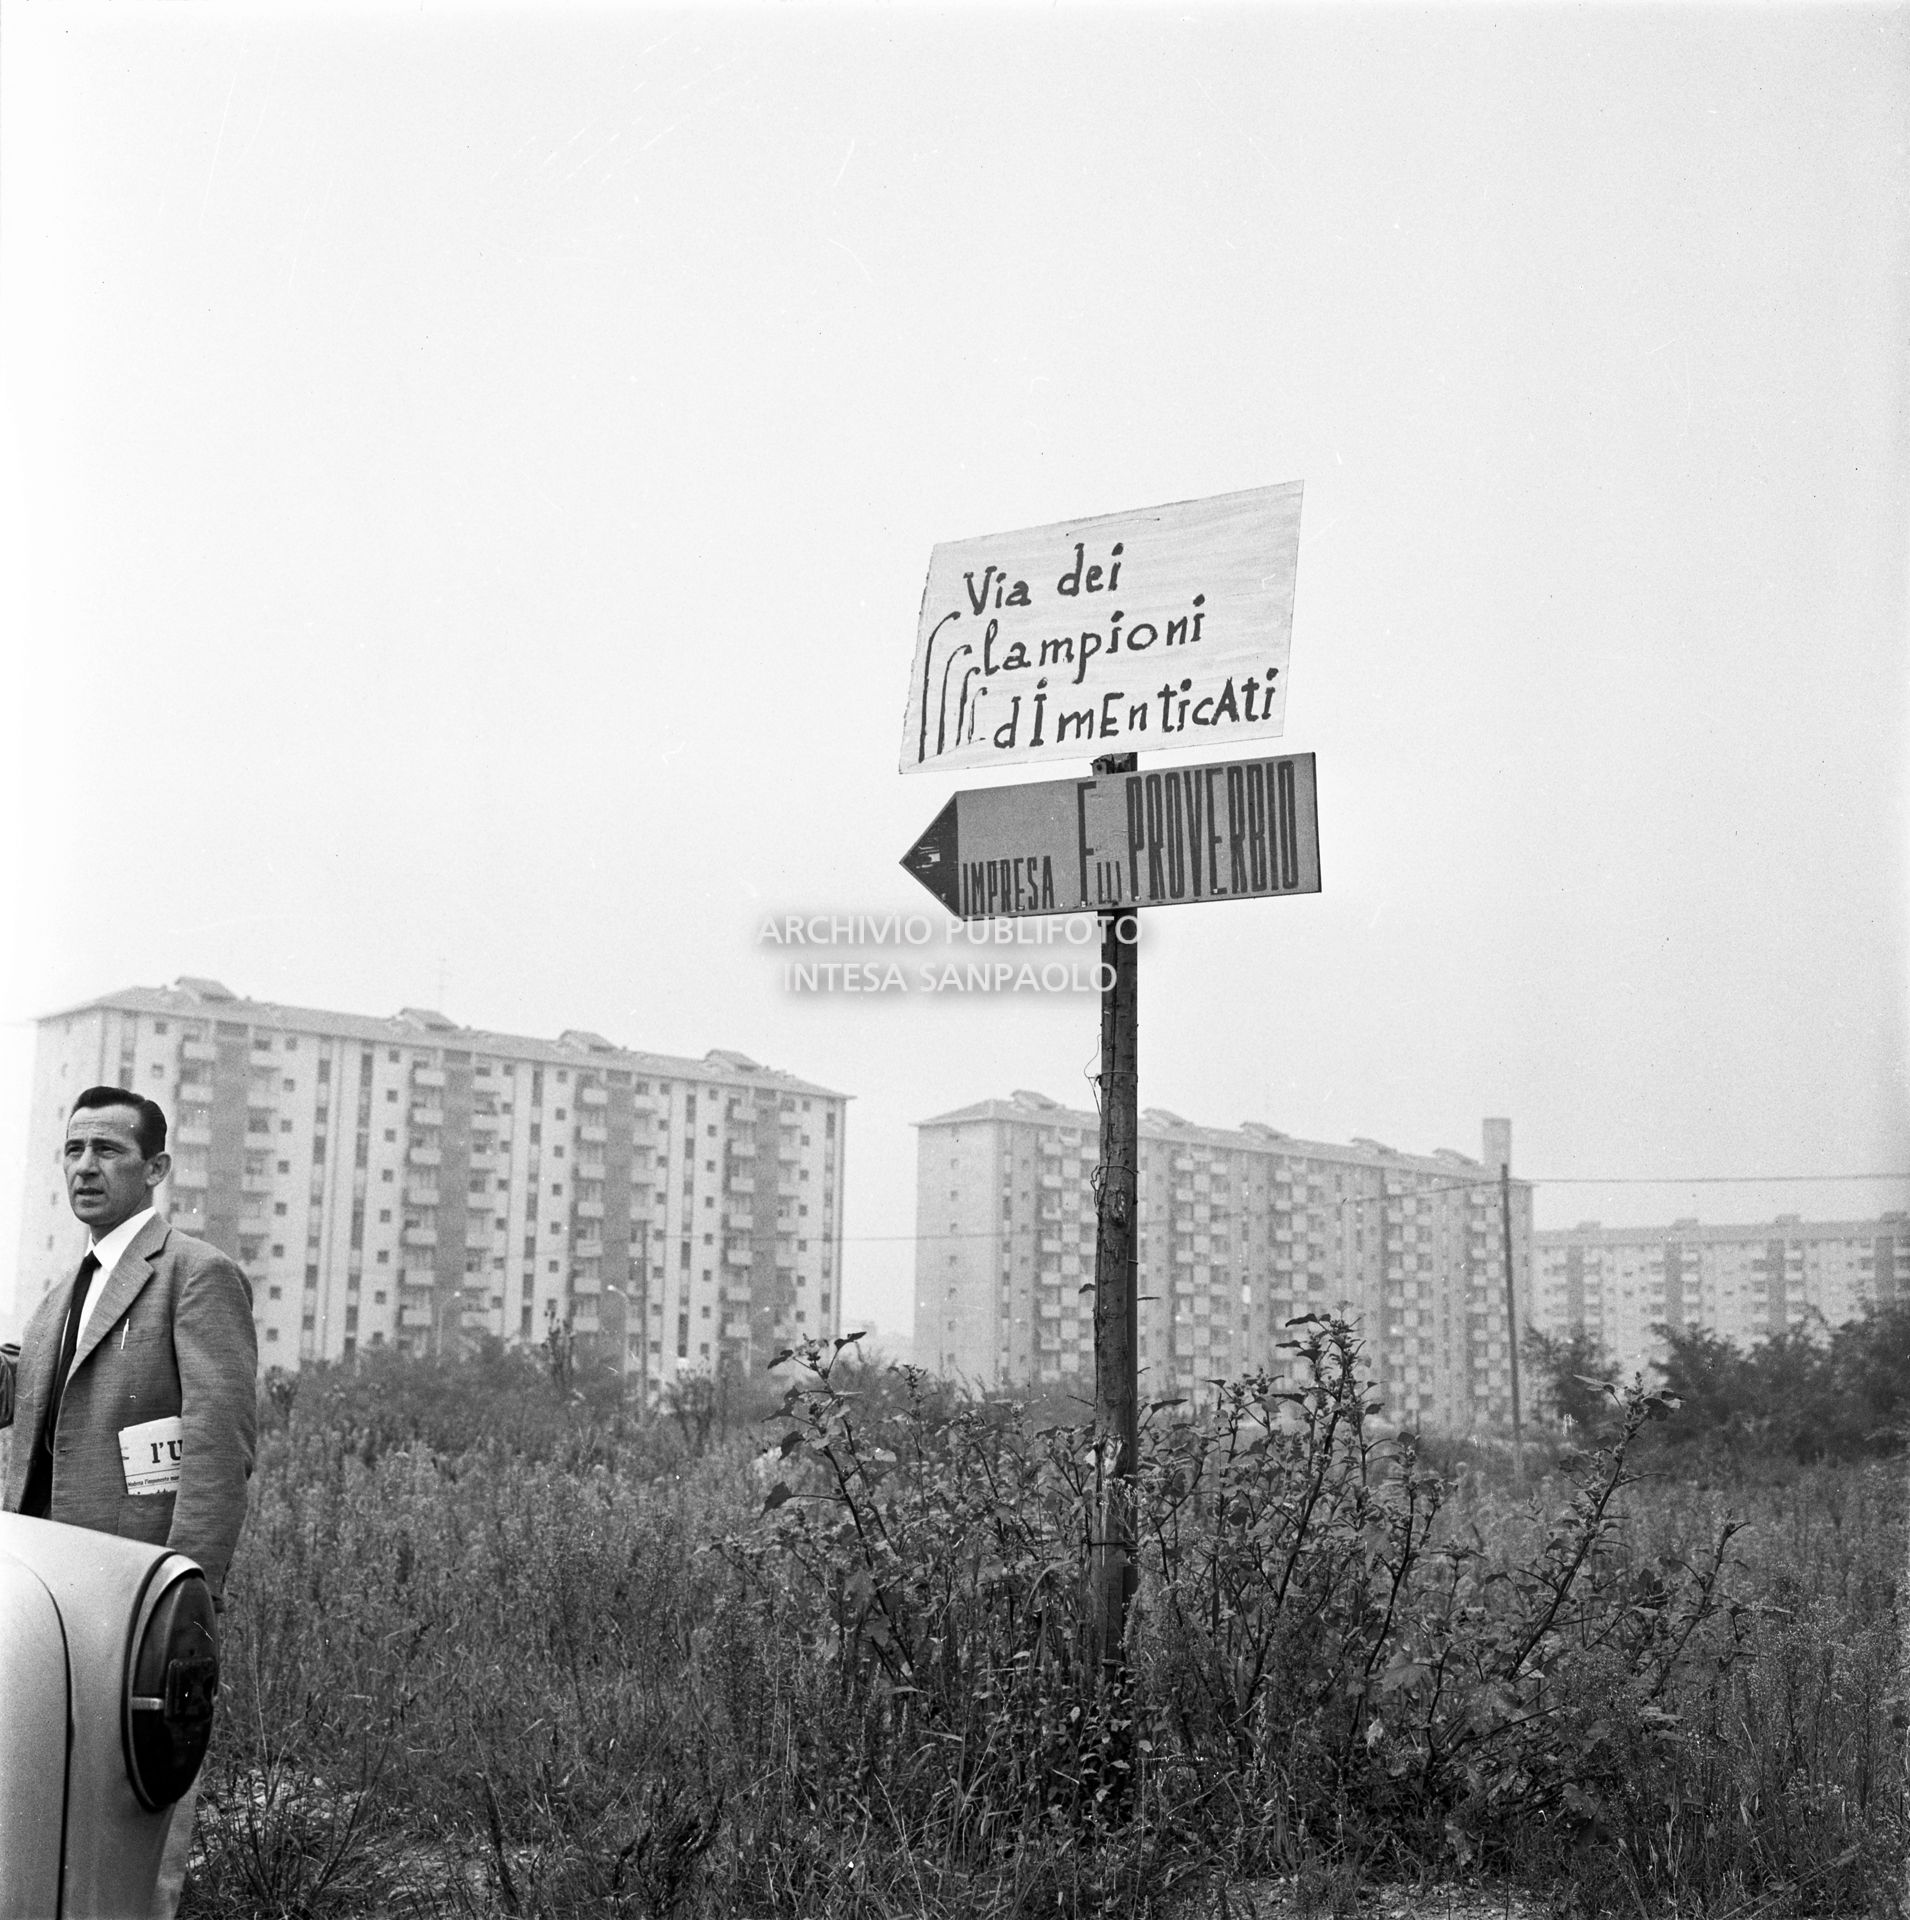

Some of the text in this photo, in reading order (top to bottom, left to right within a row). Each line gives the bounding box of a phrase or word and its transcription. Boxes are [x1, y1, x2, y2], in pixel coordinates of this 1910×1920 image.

[963, 542, 1125, 616] Via dei
[983, 594, 1206, 685] lampioni
[962, 856, 1055, 915] IMPRESA
[1125, 760, 1300, 901] PROVERBIO
